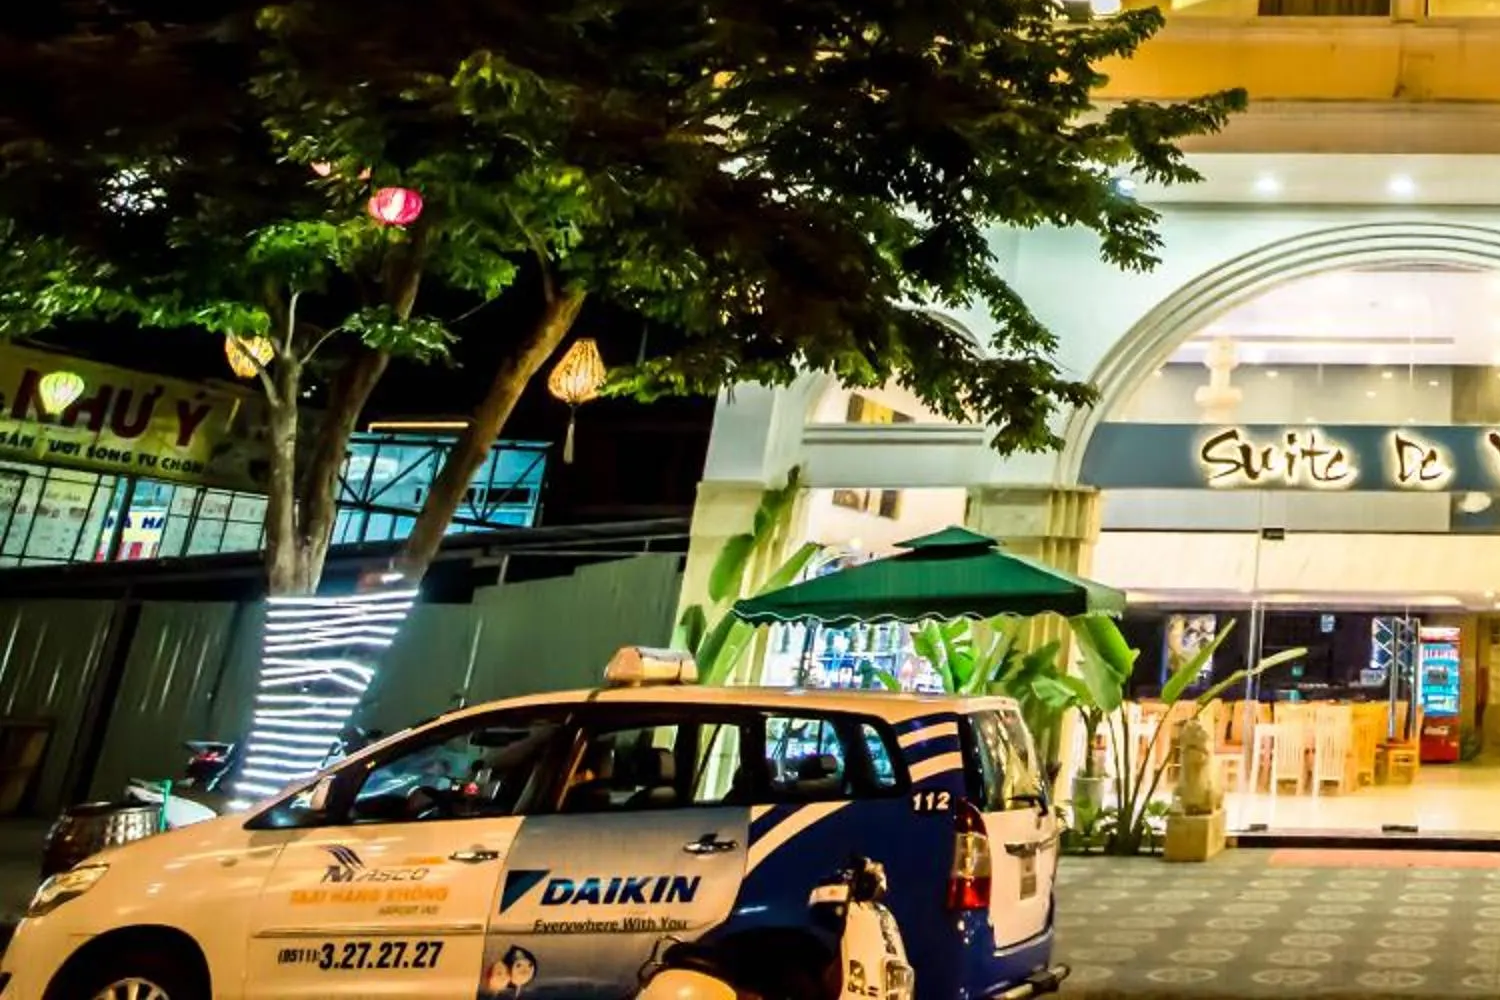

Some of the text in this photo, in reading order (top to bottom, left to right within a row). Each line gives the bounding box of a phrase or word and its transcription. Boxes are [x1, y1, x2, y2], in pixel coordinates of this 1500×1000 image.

[1200, 428, 1350, 484] Suite
[1394, 431, 1447, 484] De
[912, 791, 950, 811] 112
[321, 864, 430, 883] MASCO
[540, 876, 701, 905] DAIKIN
[533, 916, 688, 934] Everywhere With You
